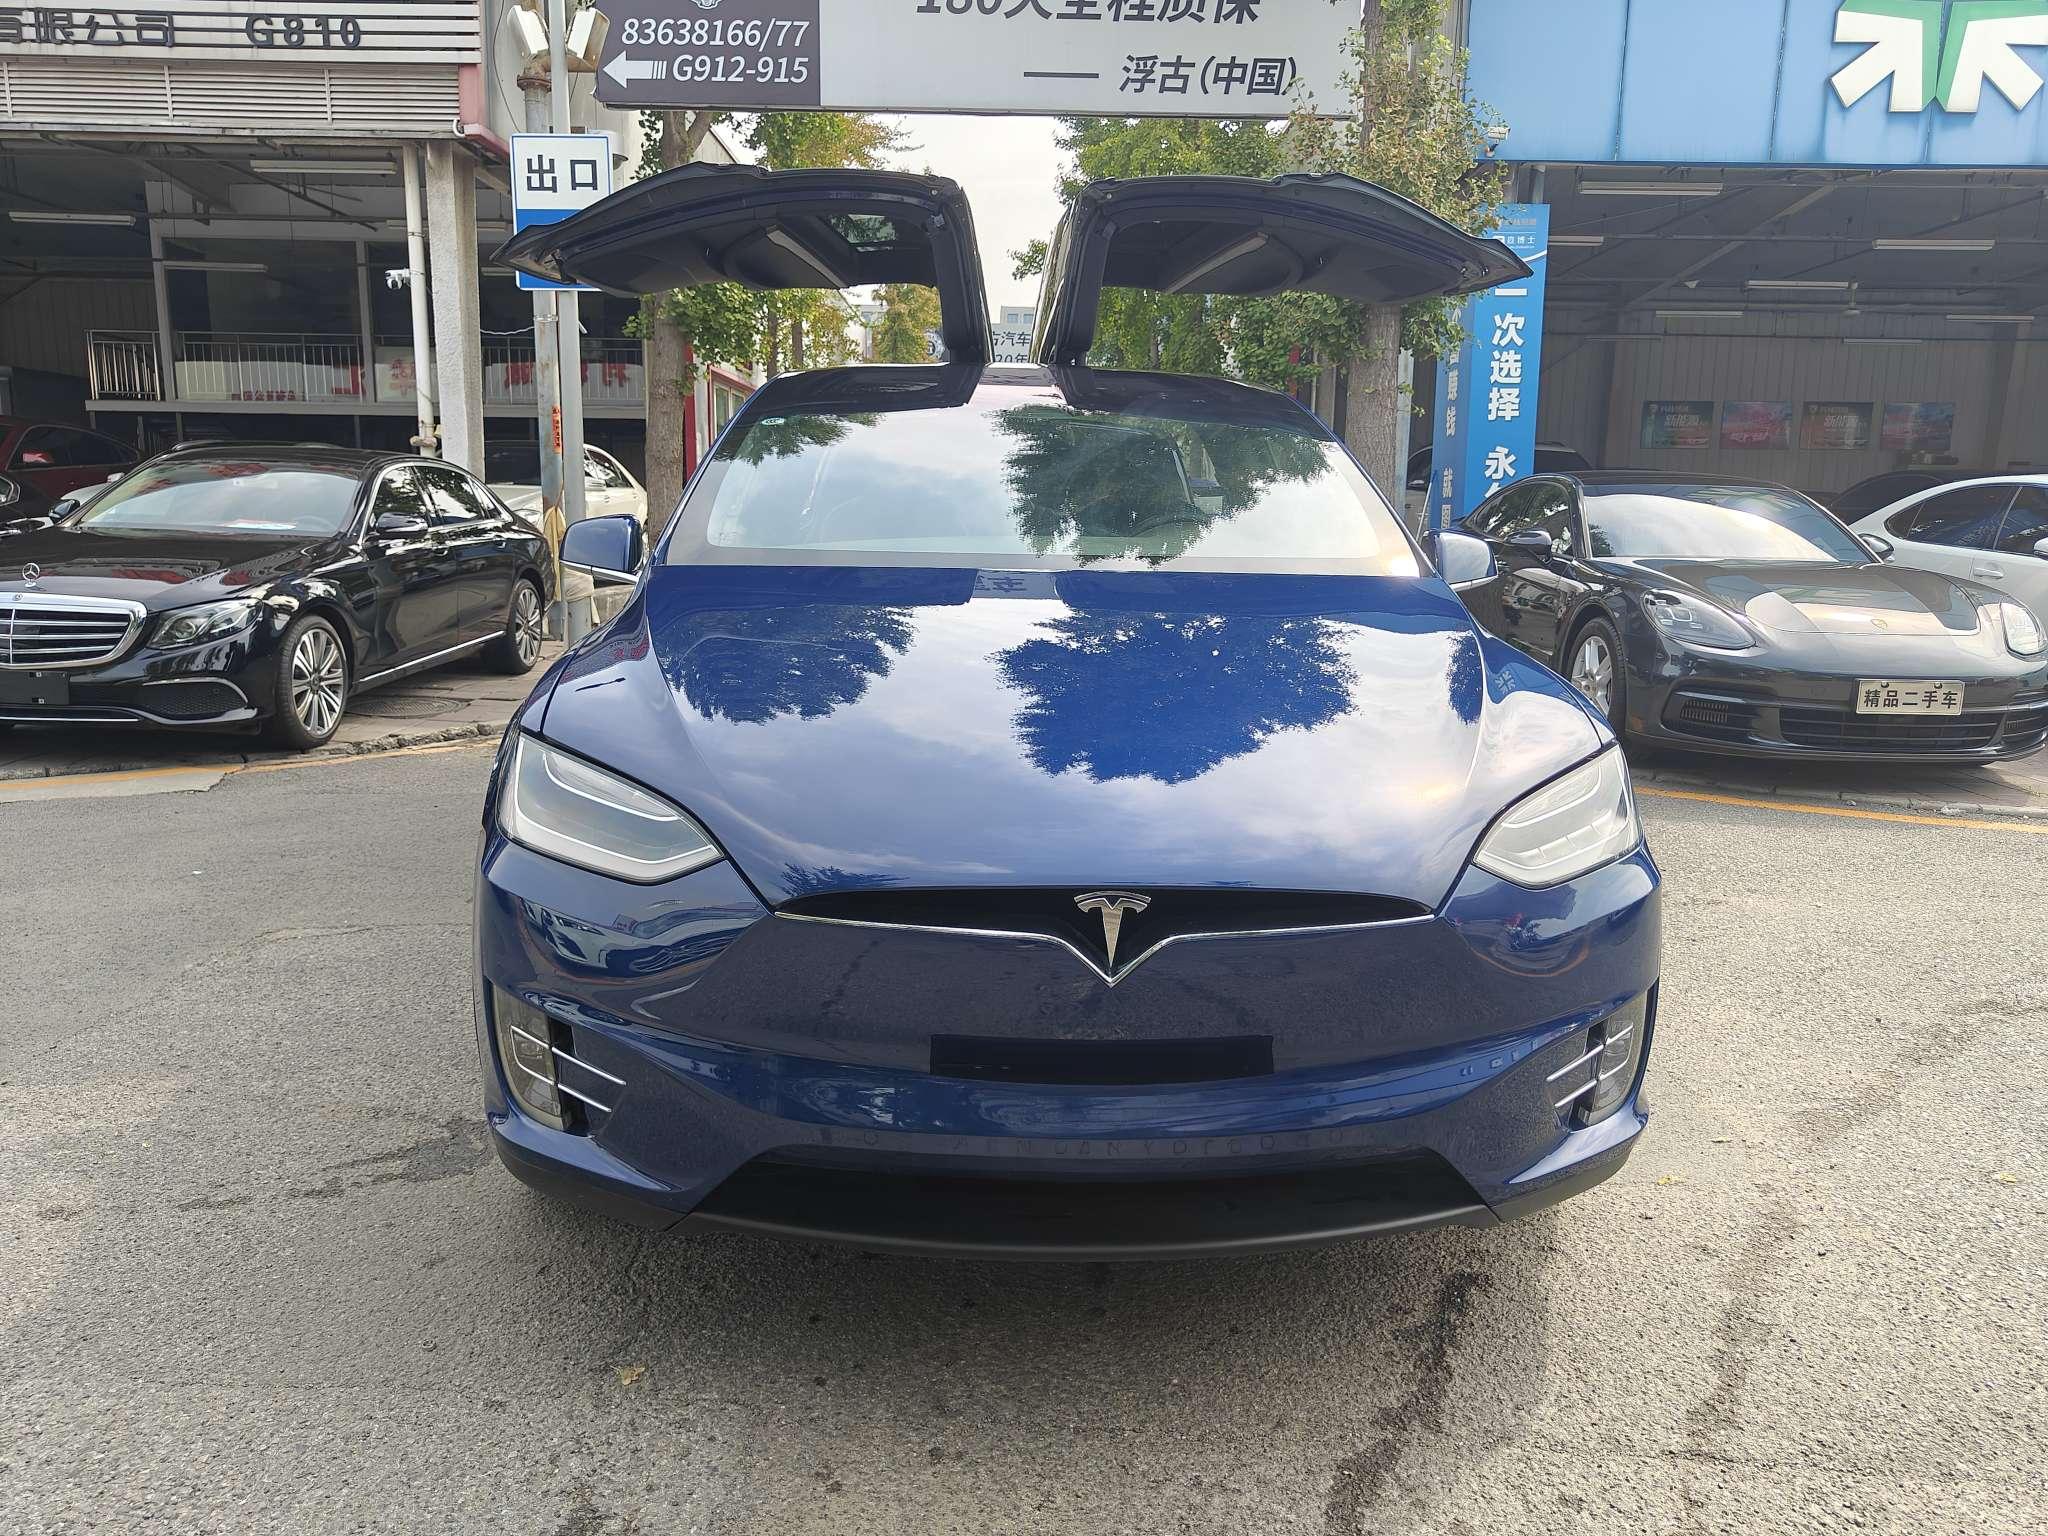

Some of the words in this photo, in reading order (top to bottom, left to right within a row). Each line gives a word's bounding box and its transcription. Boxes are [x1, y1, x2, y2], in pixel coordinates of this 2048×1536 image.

[246, 14, 362, 48] G810
[621, 17, 810, 52] 83638166/77
[672, 54, 809, 84] G912-915
[1119, 54, 1297, 96] 浮古(中国)
[526, 154, 598, 193] 出口
[1489, 288, 1528, 421] 一次选择
[1863, 688, 1958, 709] 精品二手车
